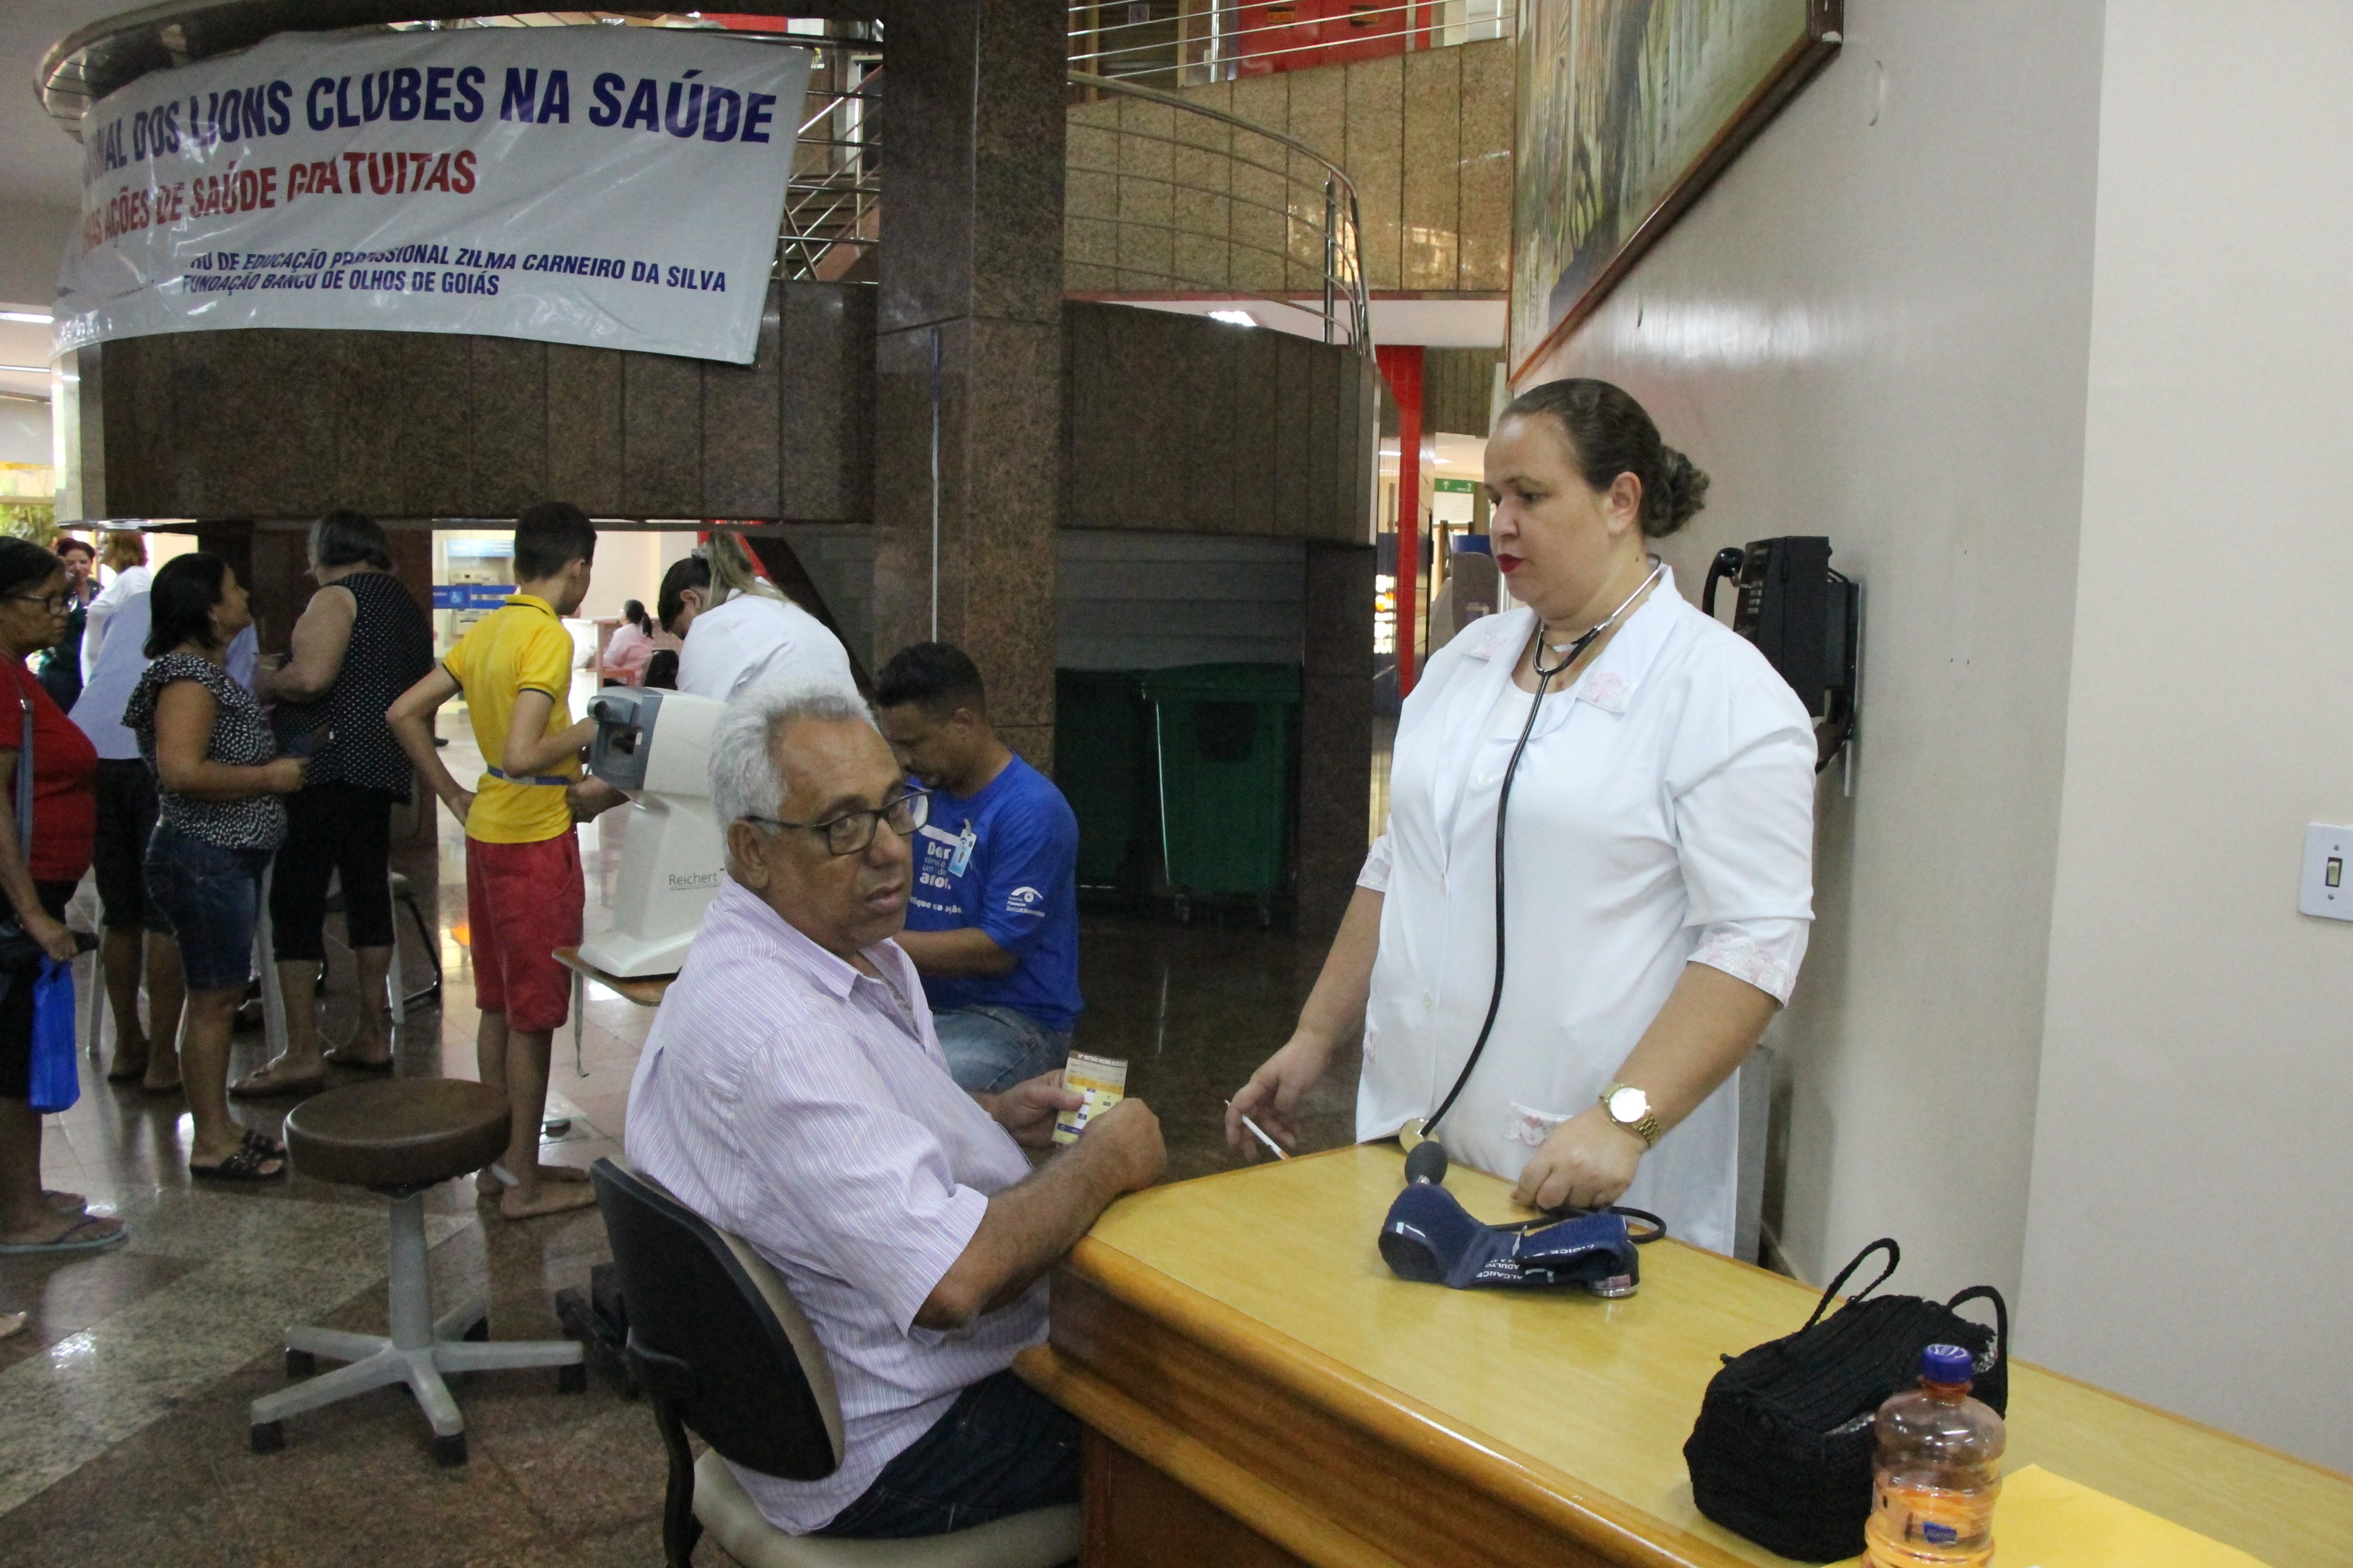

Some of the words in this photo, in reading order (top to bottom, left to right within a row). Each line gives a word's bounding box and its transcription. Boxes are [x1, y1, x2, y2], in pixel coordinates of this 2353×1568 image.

[132, 101, 180, 162] DOS
[190, 80, 292, 148] LIONS
[306, 66, 486, 132] CLUBES
[500, 67, 569, 124] NA
[588, 69, 777, 144] SAÚDE
[105, 186, 151, 248] AÇÕES
[155, 182, 185, 225] DE
[190, 160, 277, 220] SAÚDE
[183, 272, 261, 296] FUNDAÇÃO
[261, 273, 319, 290] BANCO
[321, 270, 345, 289] DE
[349, 270, 406, 291] OLHOS
[411, 272, 436, 292] DE
[442, 270, 500, 296] GOIÁS
[218, 252, 240, 271] DE
[241, 248, 328, 273] EDUCAÇÃO
[455, 248, 517, 270] ZILMA
[522, 254, 625, 279] CARNEIRO
[631, 261, 660, 284] DA
[667, 266, 727, 292] SILVA
[669, 872, 717, 885] Reichert
